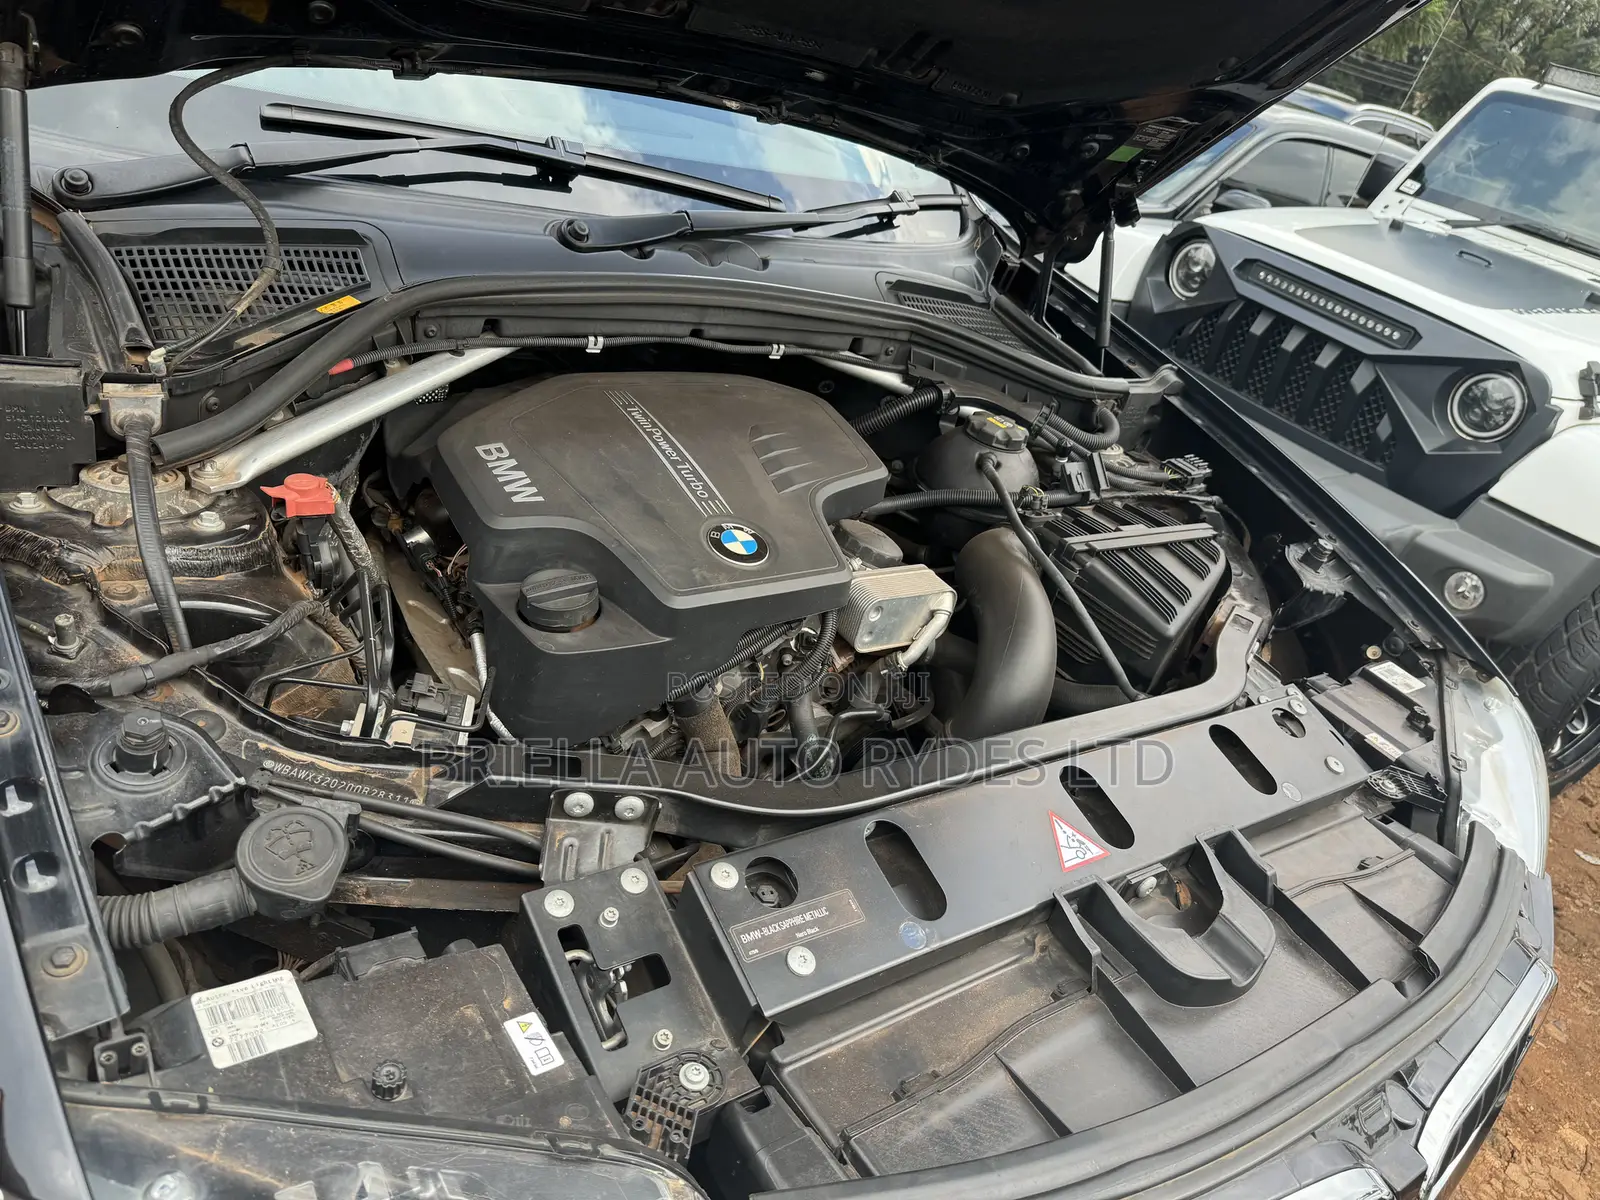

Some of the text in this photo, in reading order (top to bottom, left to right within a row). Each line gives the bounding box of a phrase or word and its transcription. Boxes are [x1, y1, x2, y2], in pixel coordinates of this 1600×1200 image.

[626, 405, 709, 499] TwinPower Turbo
[474, 442, 545, 503] BMW
[710, 523, 756, 540] BMW
[779, 914, 806, 931] SAPPHIRE
[802, 906, 829, 923] METALLIC
[806, 926, 820, 935] Black
[206, 986, 249, 1000] Autotive
